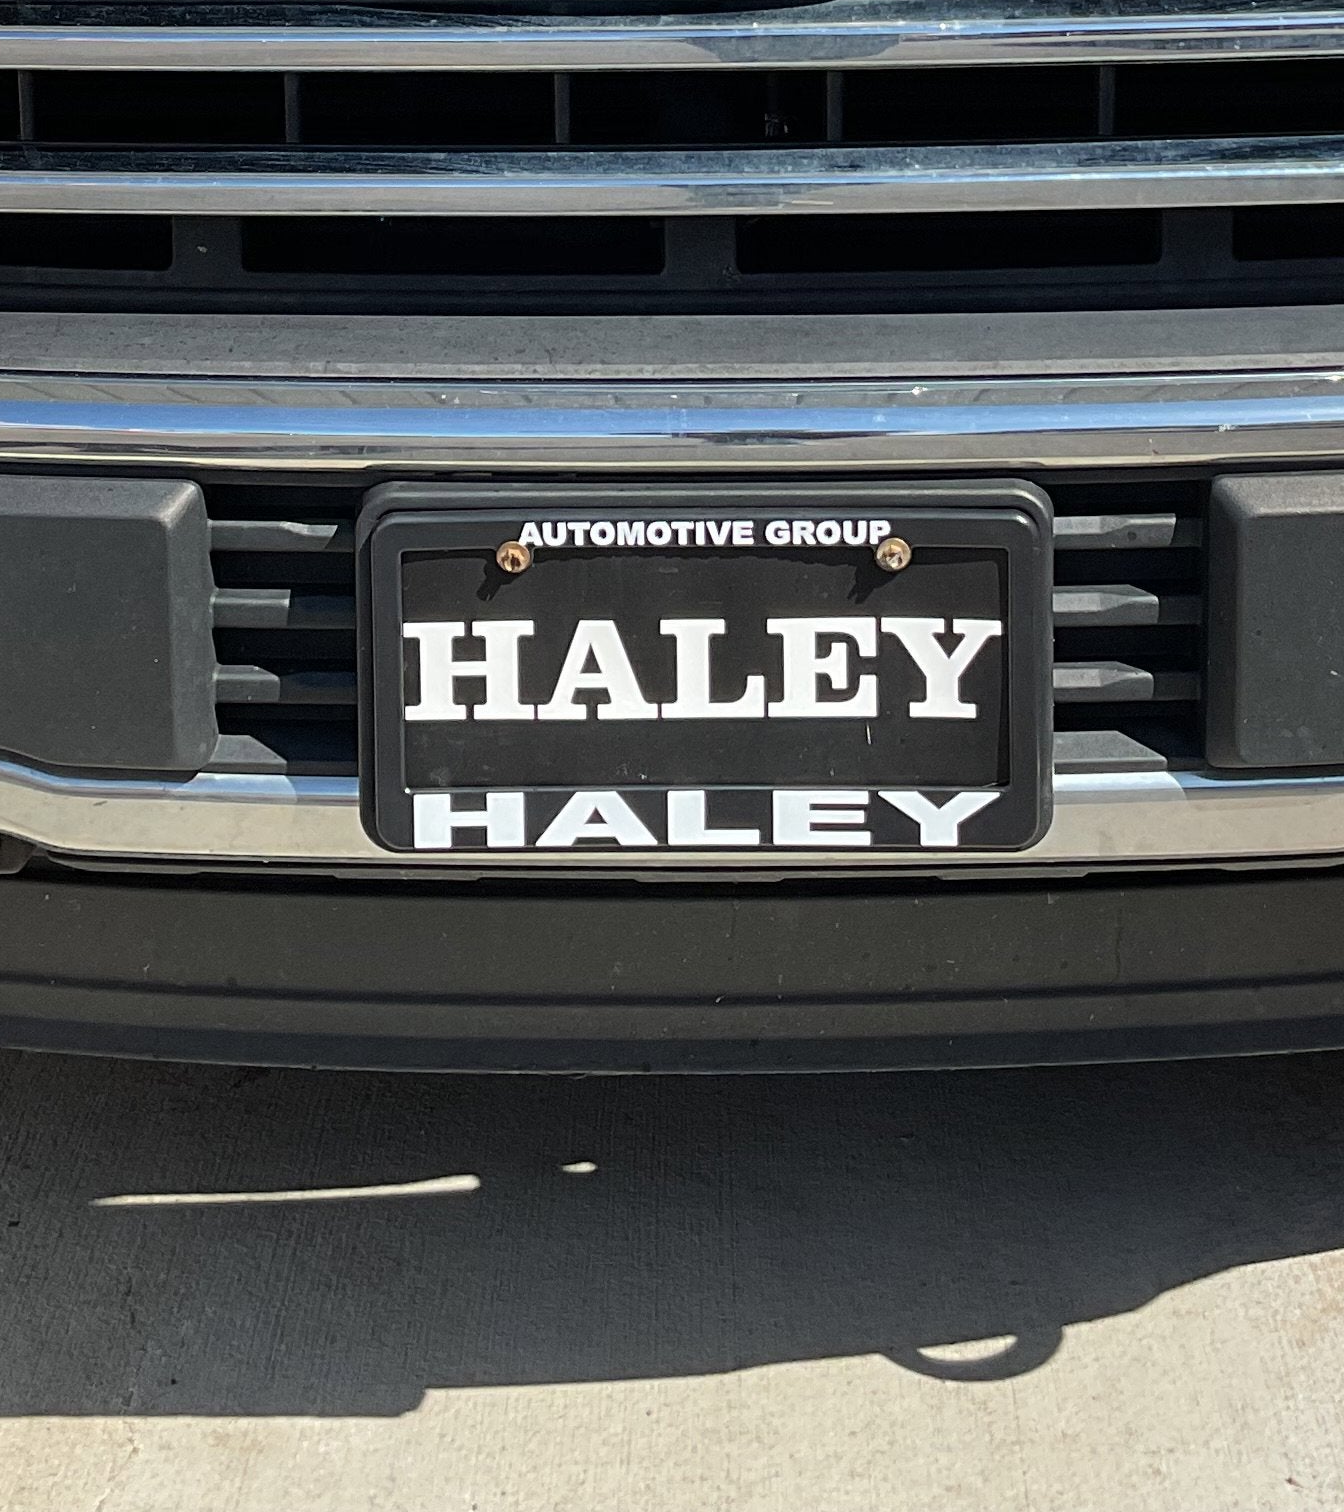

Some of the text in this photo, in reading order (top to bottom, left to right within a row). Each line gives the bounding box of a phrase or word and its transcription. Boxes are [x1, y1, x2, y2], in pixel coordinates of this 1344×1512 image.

[517, 519, 892, 547] AUTOMOTIVE GROUP
[402, 618, 1003, 721] HALEY
[412, 790, 1001, 849] HALEY
